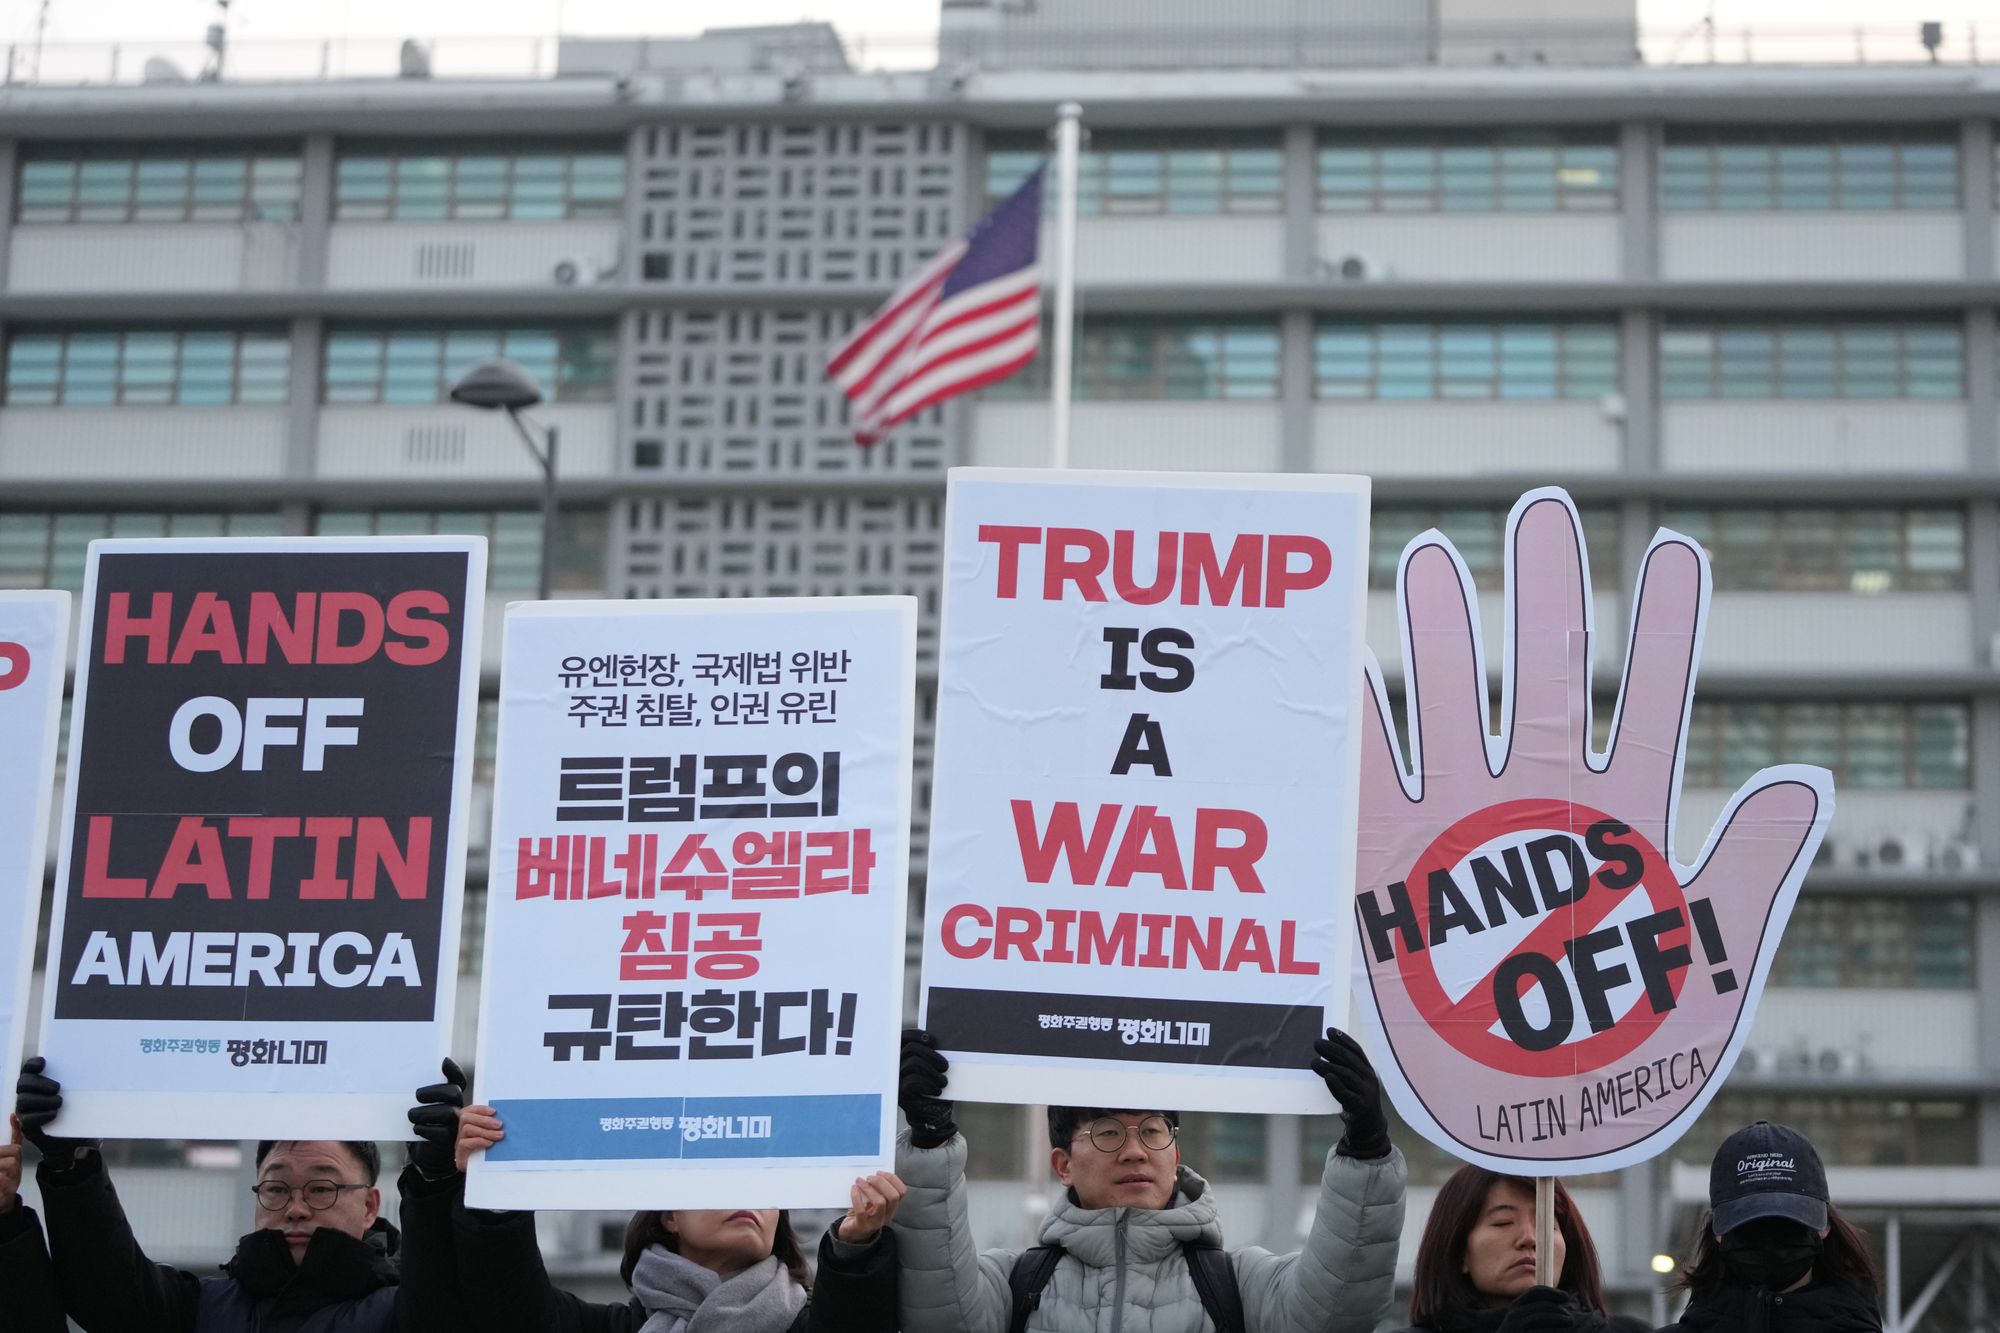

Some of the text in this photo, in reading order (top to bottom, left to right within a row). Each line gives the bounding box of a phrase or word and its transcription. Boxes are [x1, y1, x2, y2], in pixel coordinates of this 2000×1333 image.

[979, 525, 1331, 608] TRUMP
[105, 590, 448, 665] HANDS
[1101, 627, 1194, 693] IS
[558, 649, 851, 688] 유엔헌장, 국제법 위반
[170, 696, 364, 772] OFF
[568, 690, 836, 728] 주권 침탈, 인권 유린
[1110, 713, 1172, 776] A
[557, 752, 840, 822] 트럼프의
[82, 816, 432, 899] LATIN
[516, 829, 875, 900] 베네수엘라
[1011, 800, 1267, 893] WAR
[1356, 819, 1644, 963] HANDS
[71, 931, 421, 987] AMERICA
[620, 911, 762, 980] 침공
[940, 904, 1319, 974] CRIMINAL
[1493, 897, 1738, 1052] OFF!
[140, 1039, 220, 1053] 평화주권행동
[544, 989, 857, 1061] 규탄한다!
[1039, 1015, 1112, 1031] 평화주권행동
[600, 1116, 674, 1131] 평화주권행동
[1476, 1047, 1708, 1144] LATIN AMERICA
[1737, 1158, 1795, 1171] Original
